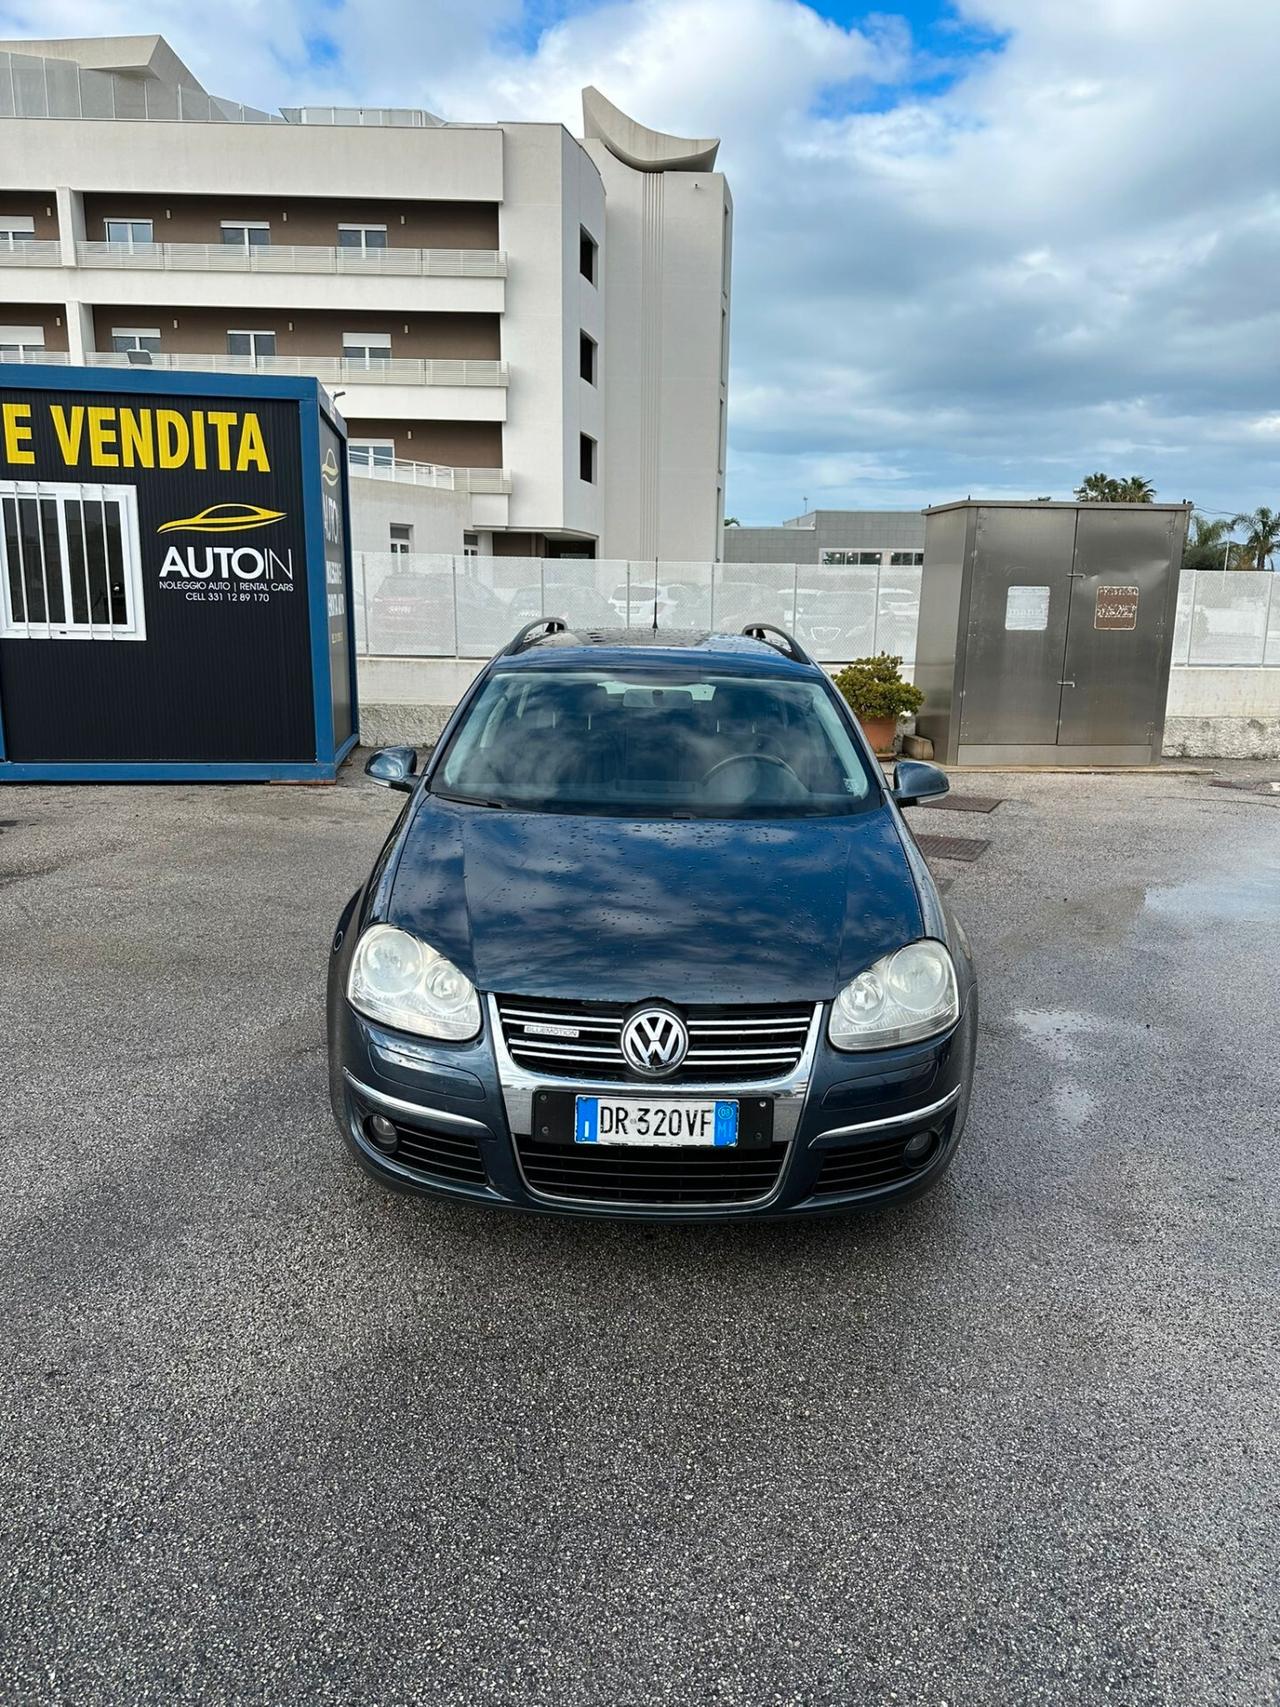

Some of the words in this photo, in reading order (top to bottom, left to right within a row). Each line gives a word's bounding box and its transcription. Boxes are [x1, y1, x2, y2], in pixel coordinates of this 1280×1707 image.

[2, 403, 35, 464] E
[49, 405, 271, 472] VENDITA
[158, 546, 293, 580] AUTOIN
[159, 581, 206, 590] NOLEGGIO
[208, 582, 231, 591] AUTO
[240, 582, 269, 591] RENTAL
[271, 583, 294, 592] CARS
[185, 592, 206, 601] CELL
[208, 592, 223, 601] 331
[227, 593, 238, 601] 12
[240, 593, 251, 601] 89
[254, 593, 270, 602] 170
[600, 1106, 628, 1135] DR
[636, 1108, 714, 1137] 320VF
